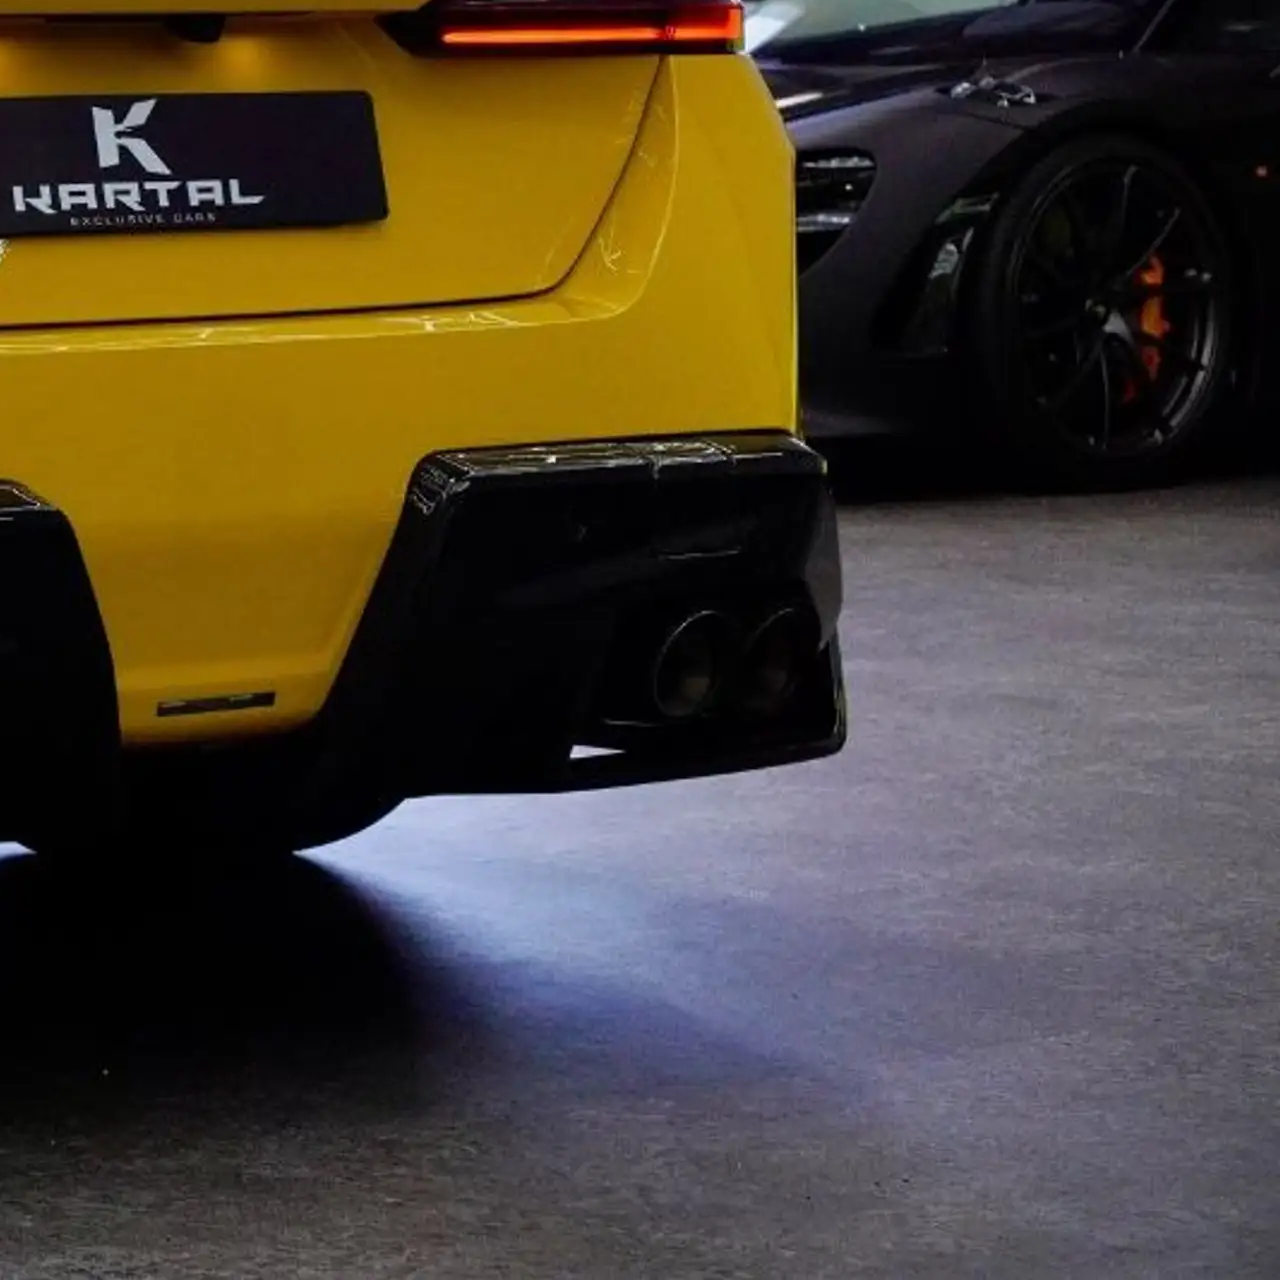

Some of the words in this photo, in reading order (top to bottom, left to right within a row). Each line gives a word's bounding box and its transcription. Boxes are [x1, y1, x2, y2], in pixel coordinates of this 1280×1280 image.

[92, 99, 171, 175] K
[12, 178, 266, 214] KARTAL
[69, 213, 165, 227] EXCLUSIVE
